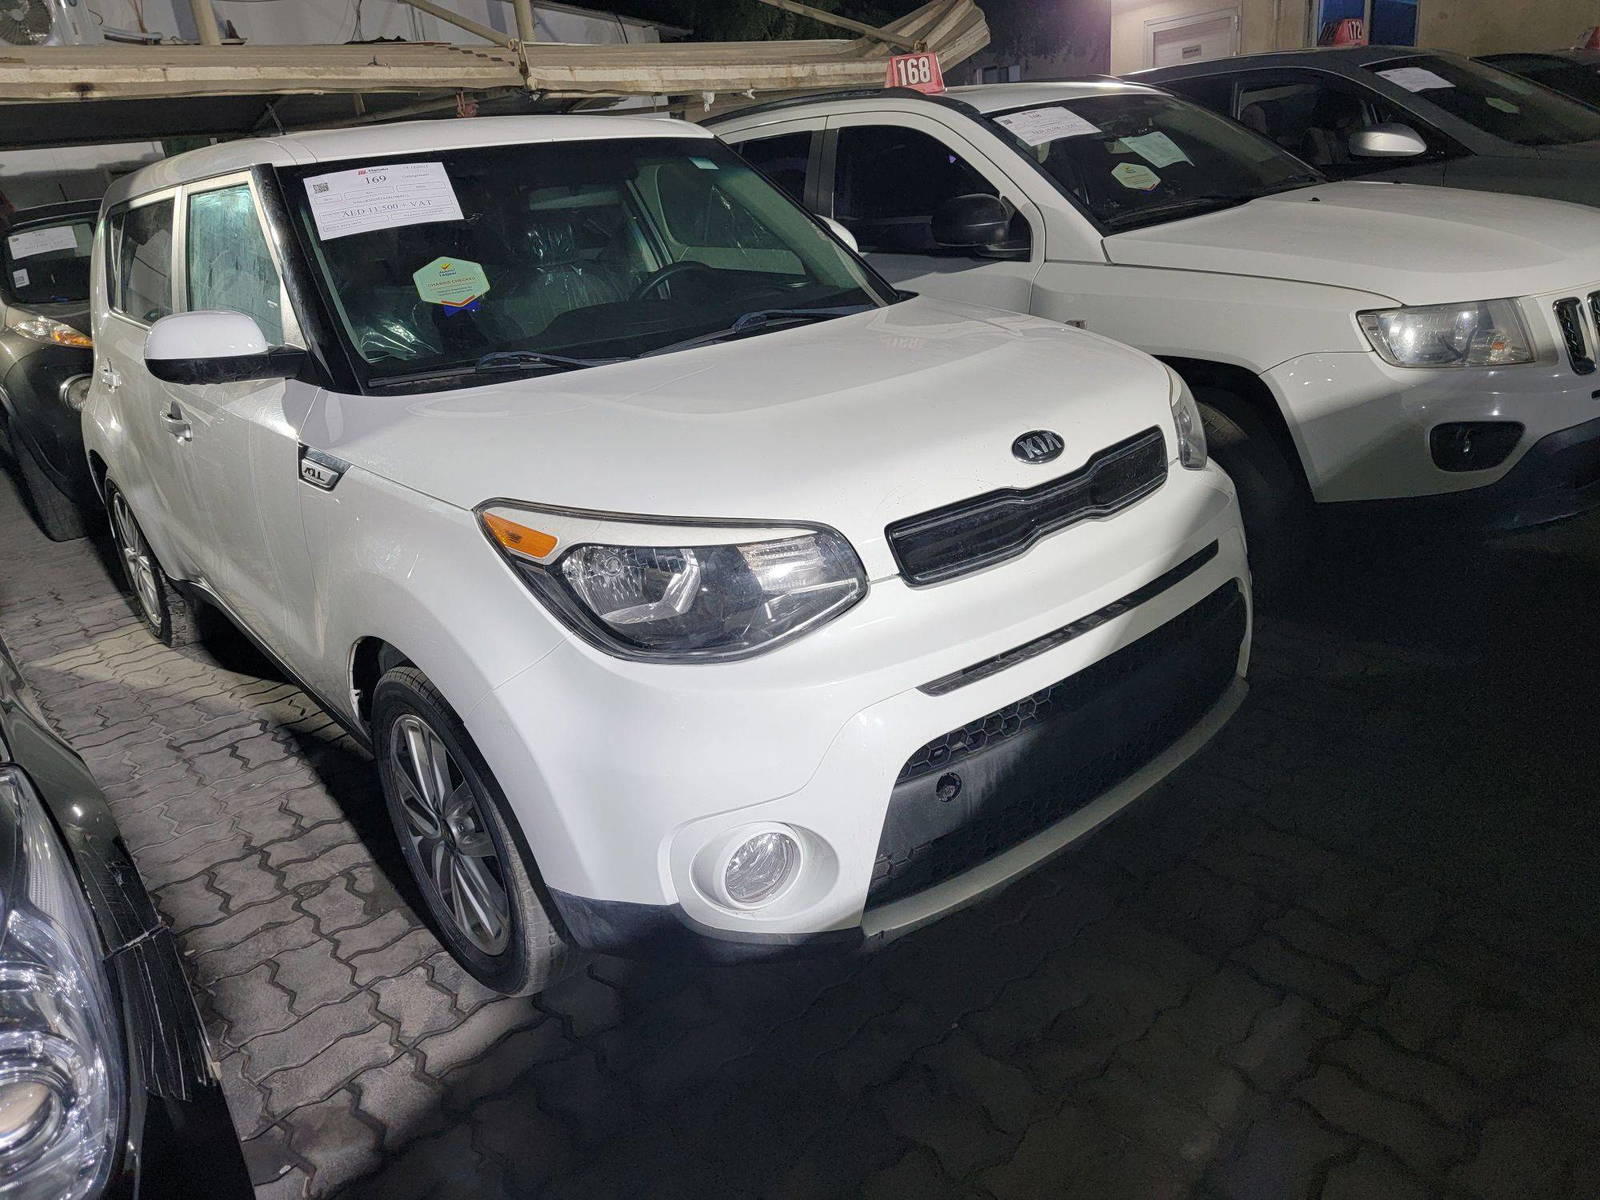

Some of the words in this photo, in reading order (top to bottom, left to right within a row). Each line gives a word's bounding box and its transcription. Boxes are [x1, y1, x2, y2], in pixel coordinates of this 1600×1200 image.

[898, 56, 931, 86] 168
[366, 175, 387, 184] 169
[1018, 432, 1062, 459] KIA
